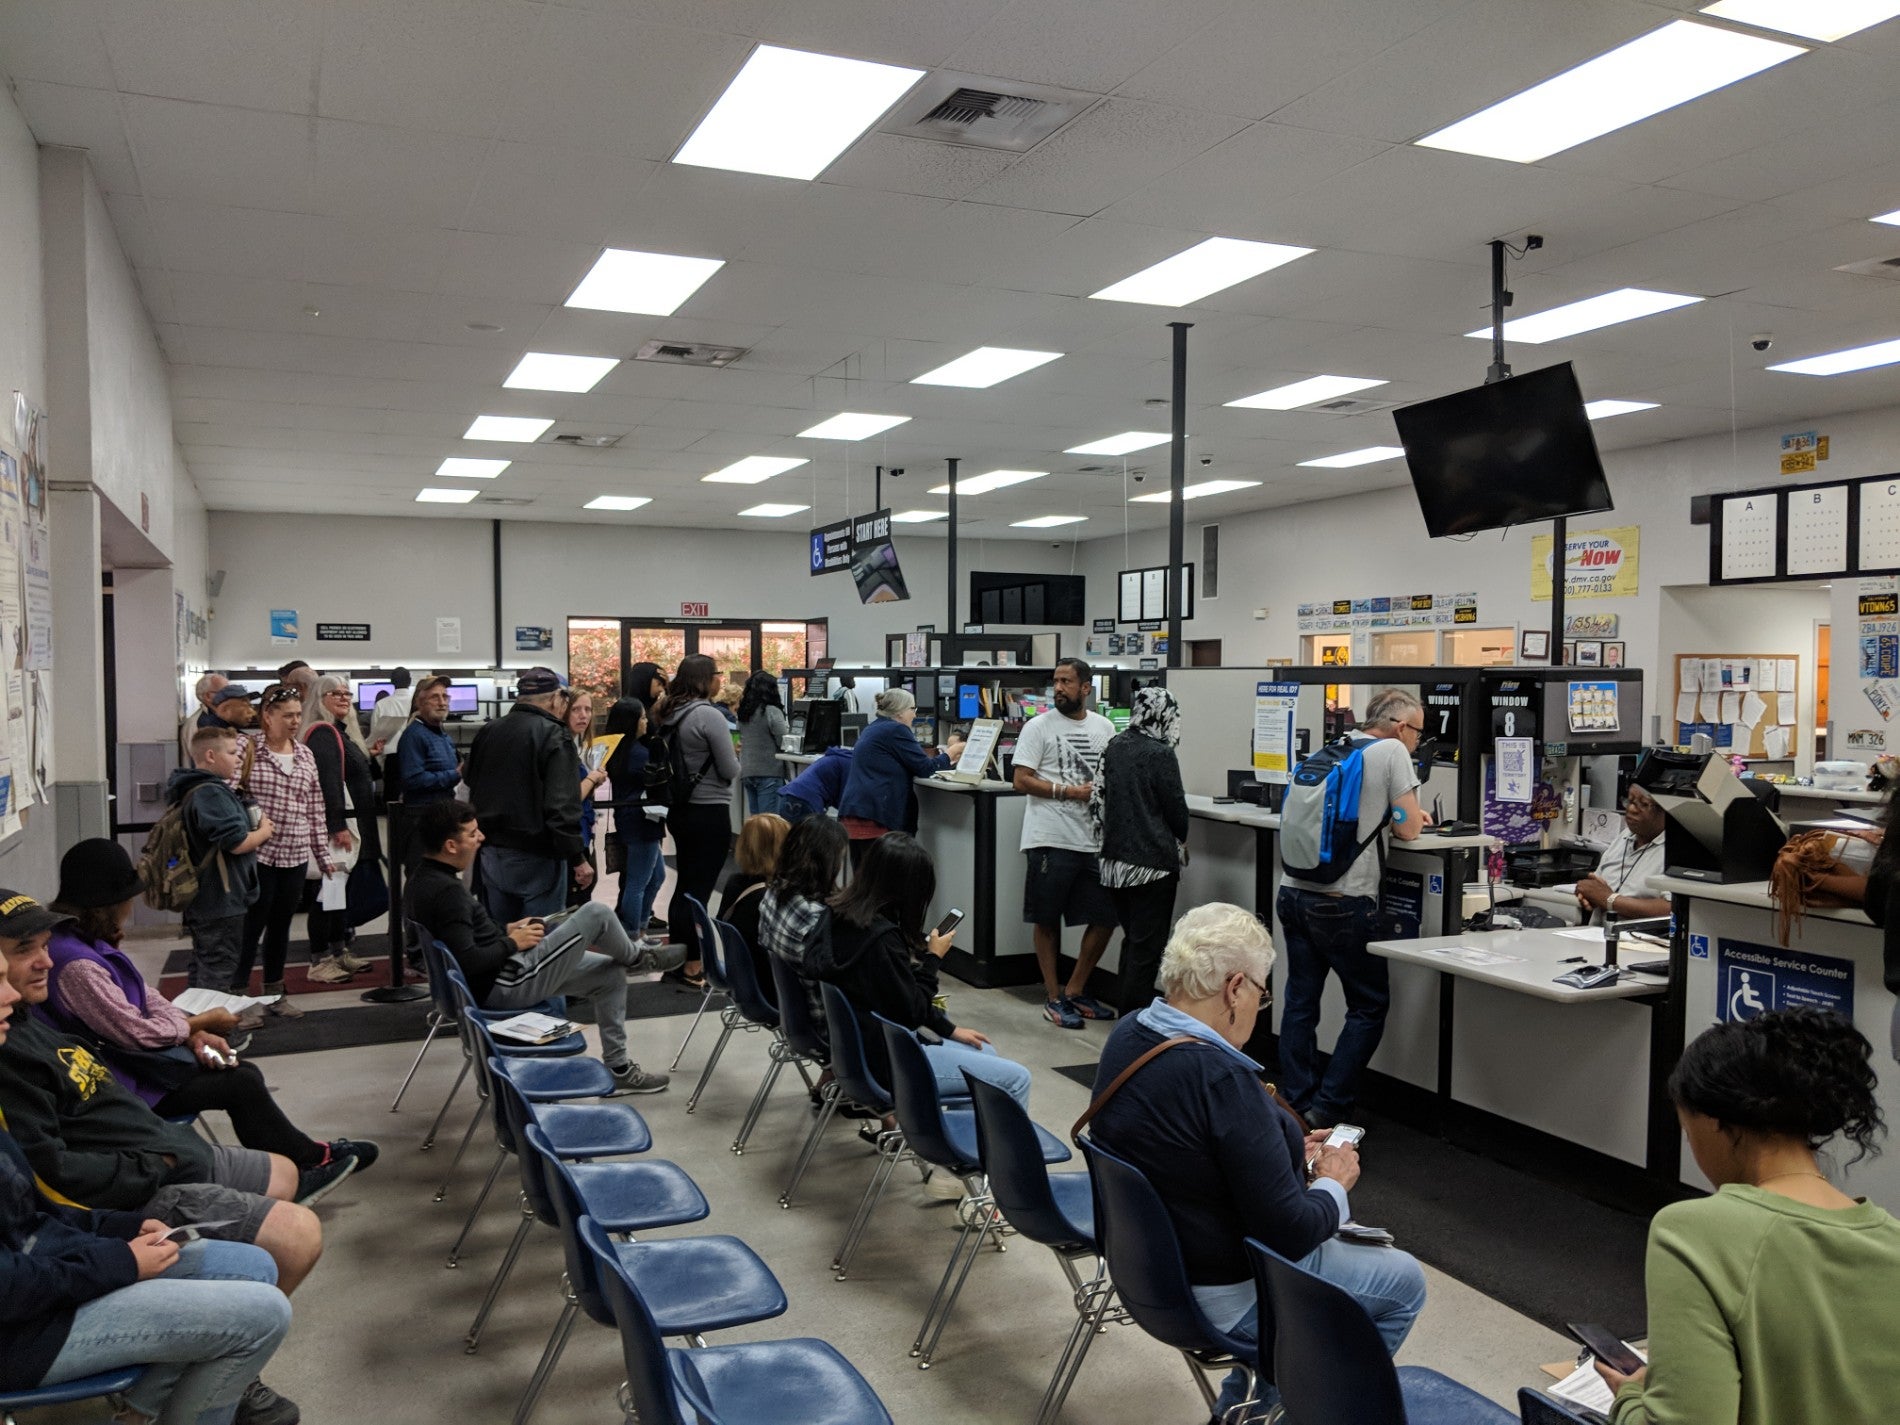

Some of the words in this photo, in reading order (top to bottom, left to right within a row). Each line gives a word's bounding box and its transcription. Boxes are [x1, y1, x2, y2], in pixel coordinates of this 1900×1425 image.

[1888, 485, 1897, 496] C
[1813, 493, 1822, 504] B
[1745, 501, 1754, 511] A
[856, 521, 873, 543] START
[873, 517, 889, 539] HERE
[1565, 542, 1587, 551] SERVE
[1589, 540, 1610, 548] YOUR
[1580, 549, 1621, 566] NOW
[1577, 584, 1613, 593] 777-0133
[682, 603, 708, 616] EXIT
[1860, 600, 1896, 613] VTOWN65
[1880, 637, 1891, 648] 65
[1880, 649, 1891, 676] COUPE
[1428, 696, 1460, 705] WINDOW
[1491, 696, 1529, 706] WINDOW
[1440, 710, 1450, 734] 7
[1504, 711, 1515, 737] 8
[1868, 734, 1885, 746] 326
[1724, 948, 1771, 965] Accessible
[1772, 957, 1807, 972] Service
[1809, 964, 1849, 979] Counter
